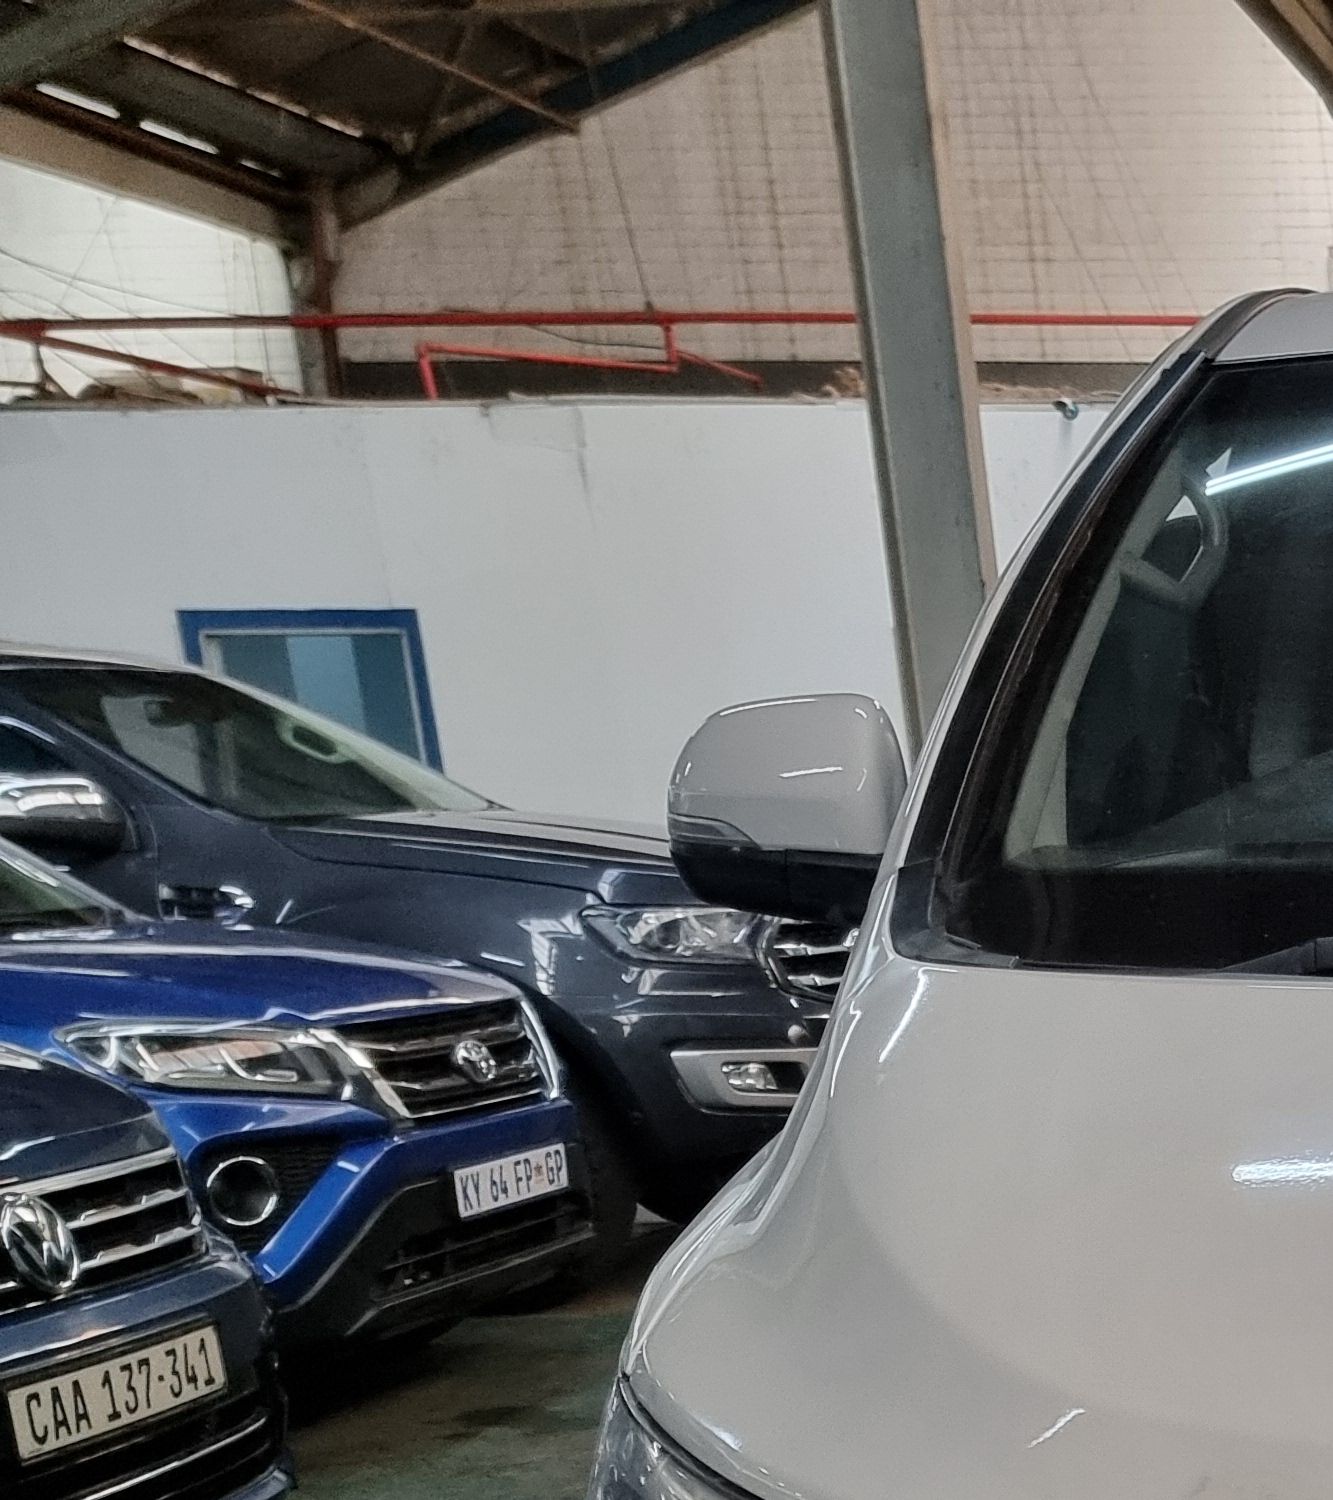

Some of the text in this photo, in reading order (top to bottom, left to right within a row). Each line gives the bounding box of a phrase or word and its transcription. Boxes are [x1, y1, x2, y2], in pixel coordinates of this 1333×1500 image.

[460, 1149, 563, 1212] KY 64 FP GP
[25, 1379, 92, 1445] CAA
